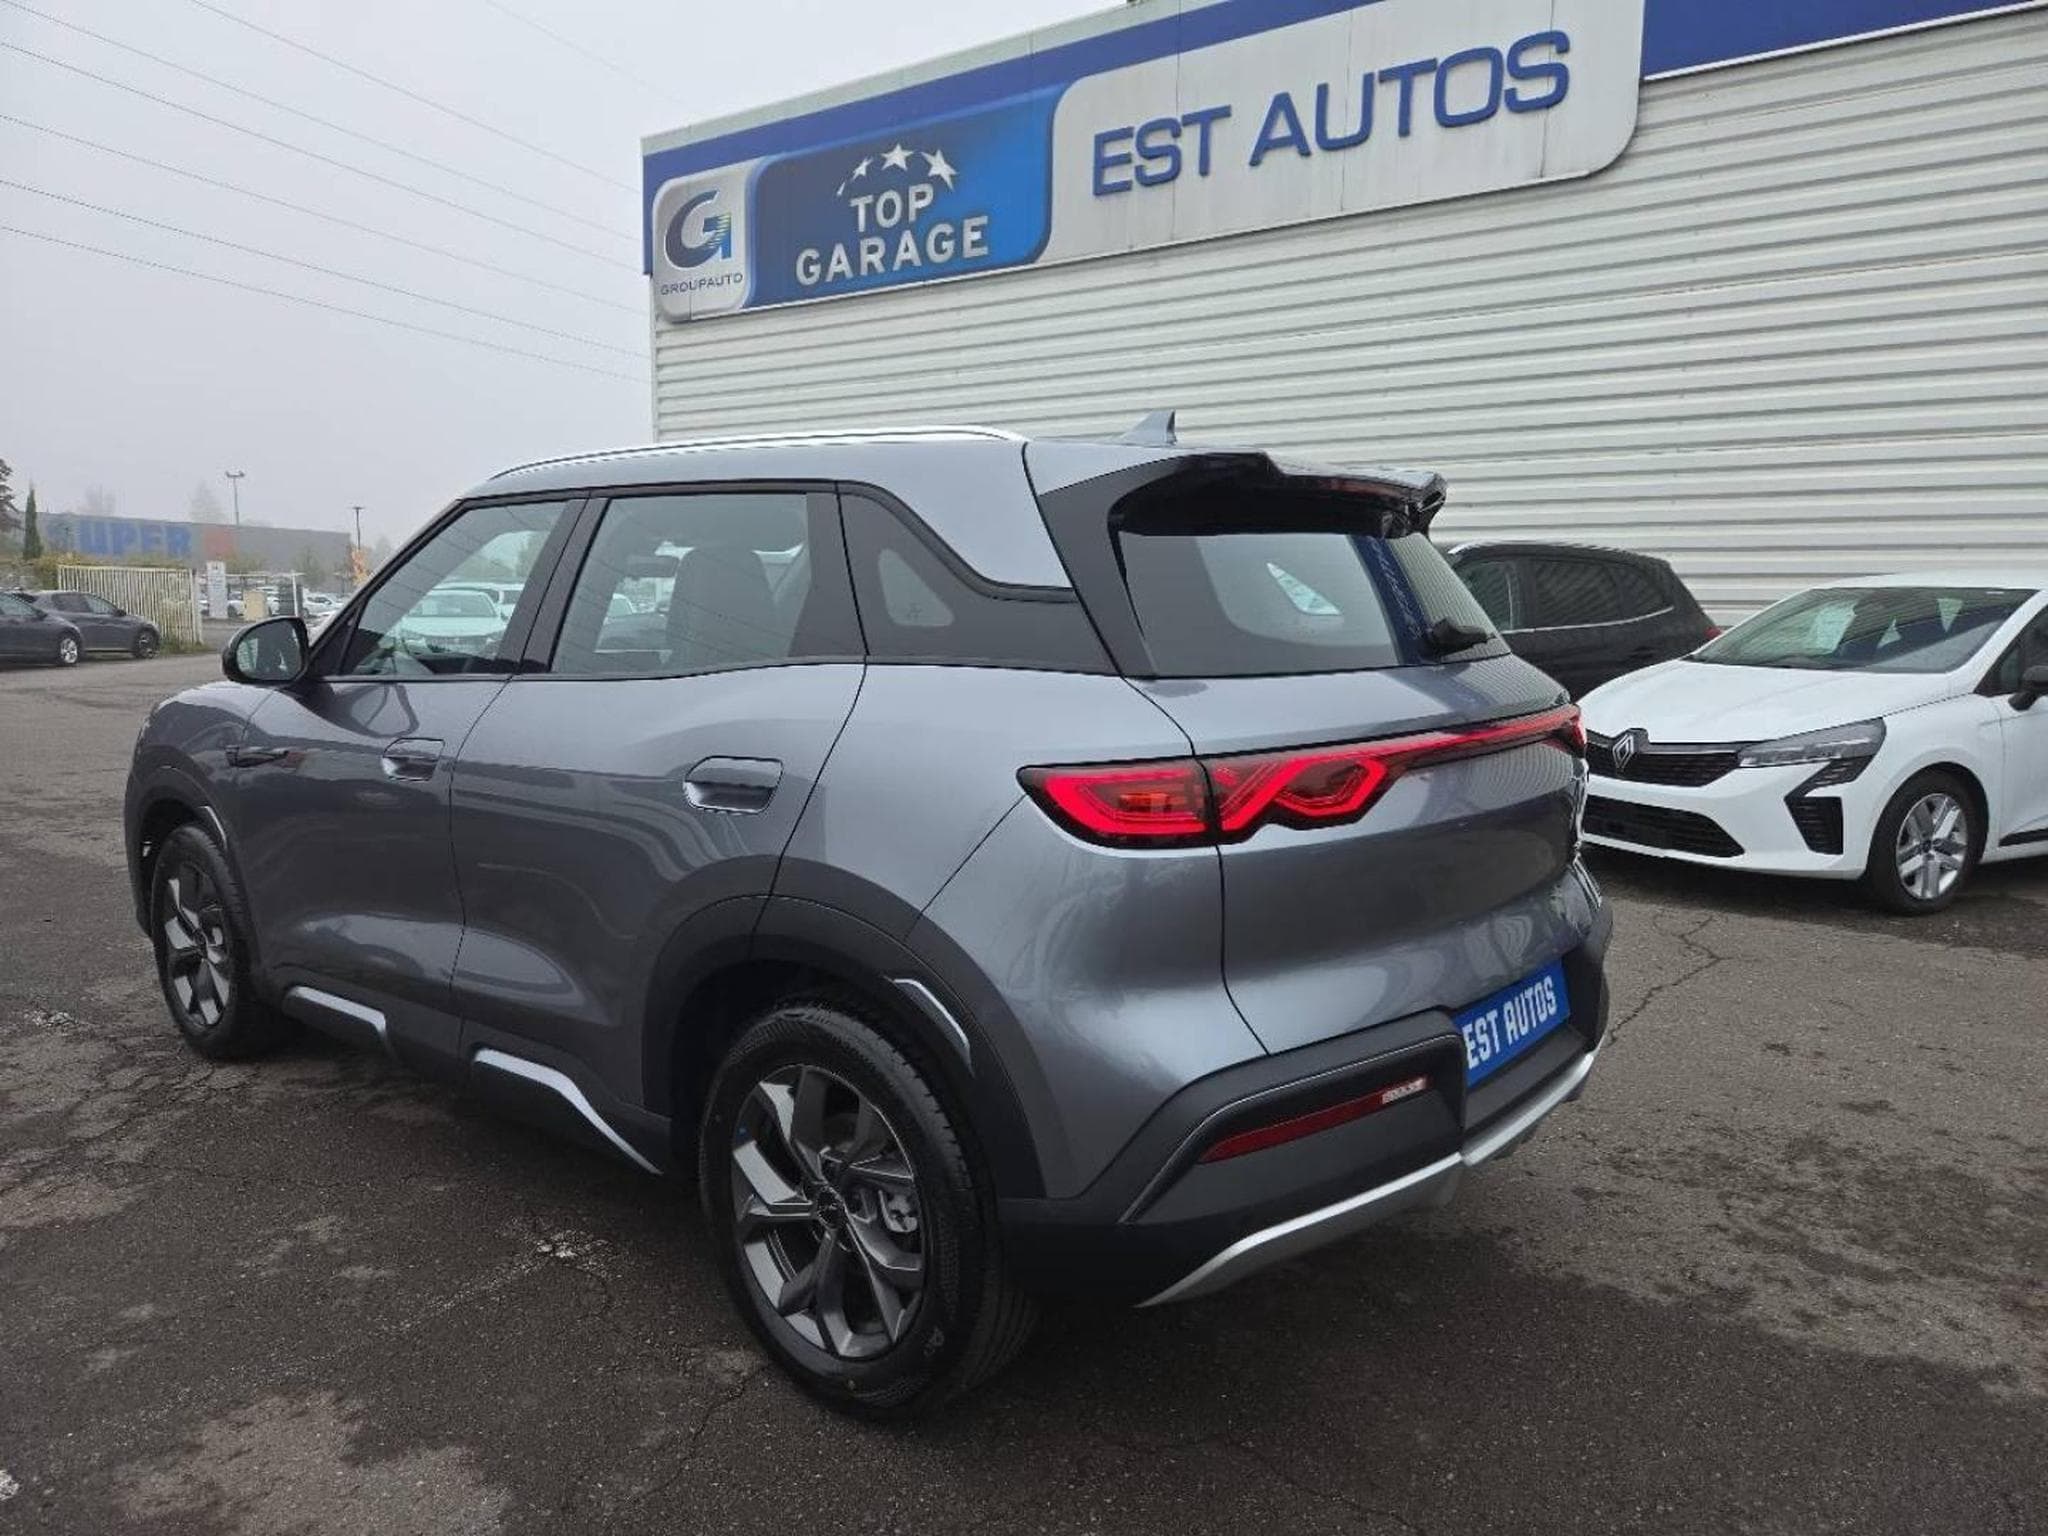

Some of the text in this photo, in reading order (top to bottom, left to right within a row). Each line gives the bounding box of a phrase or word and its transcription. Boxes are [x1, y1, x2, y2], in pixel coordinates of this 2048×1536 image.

[1093, 30, 1570, 197] EST AUTOS
[849, 183, 934, 233] TOP
[661, 273, 743, 295] GROUPAUTO
[796, 216, 988, 285] GARAGE
[1462, 976, 1557, 1069] EST AUTOS
